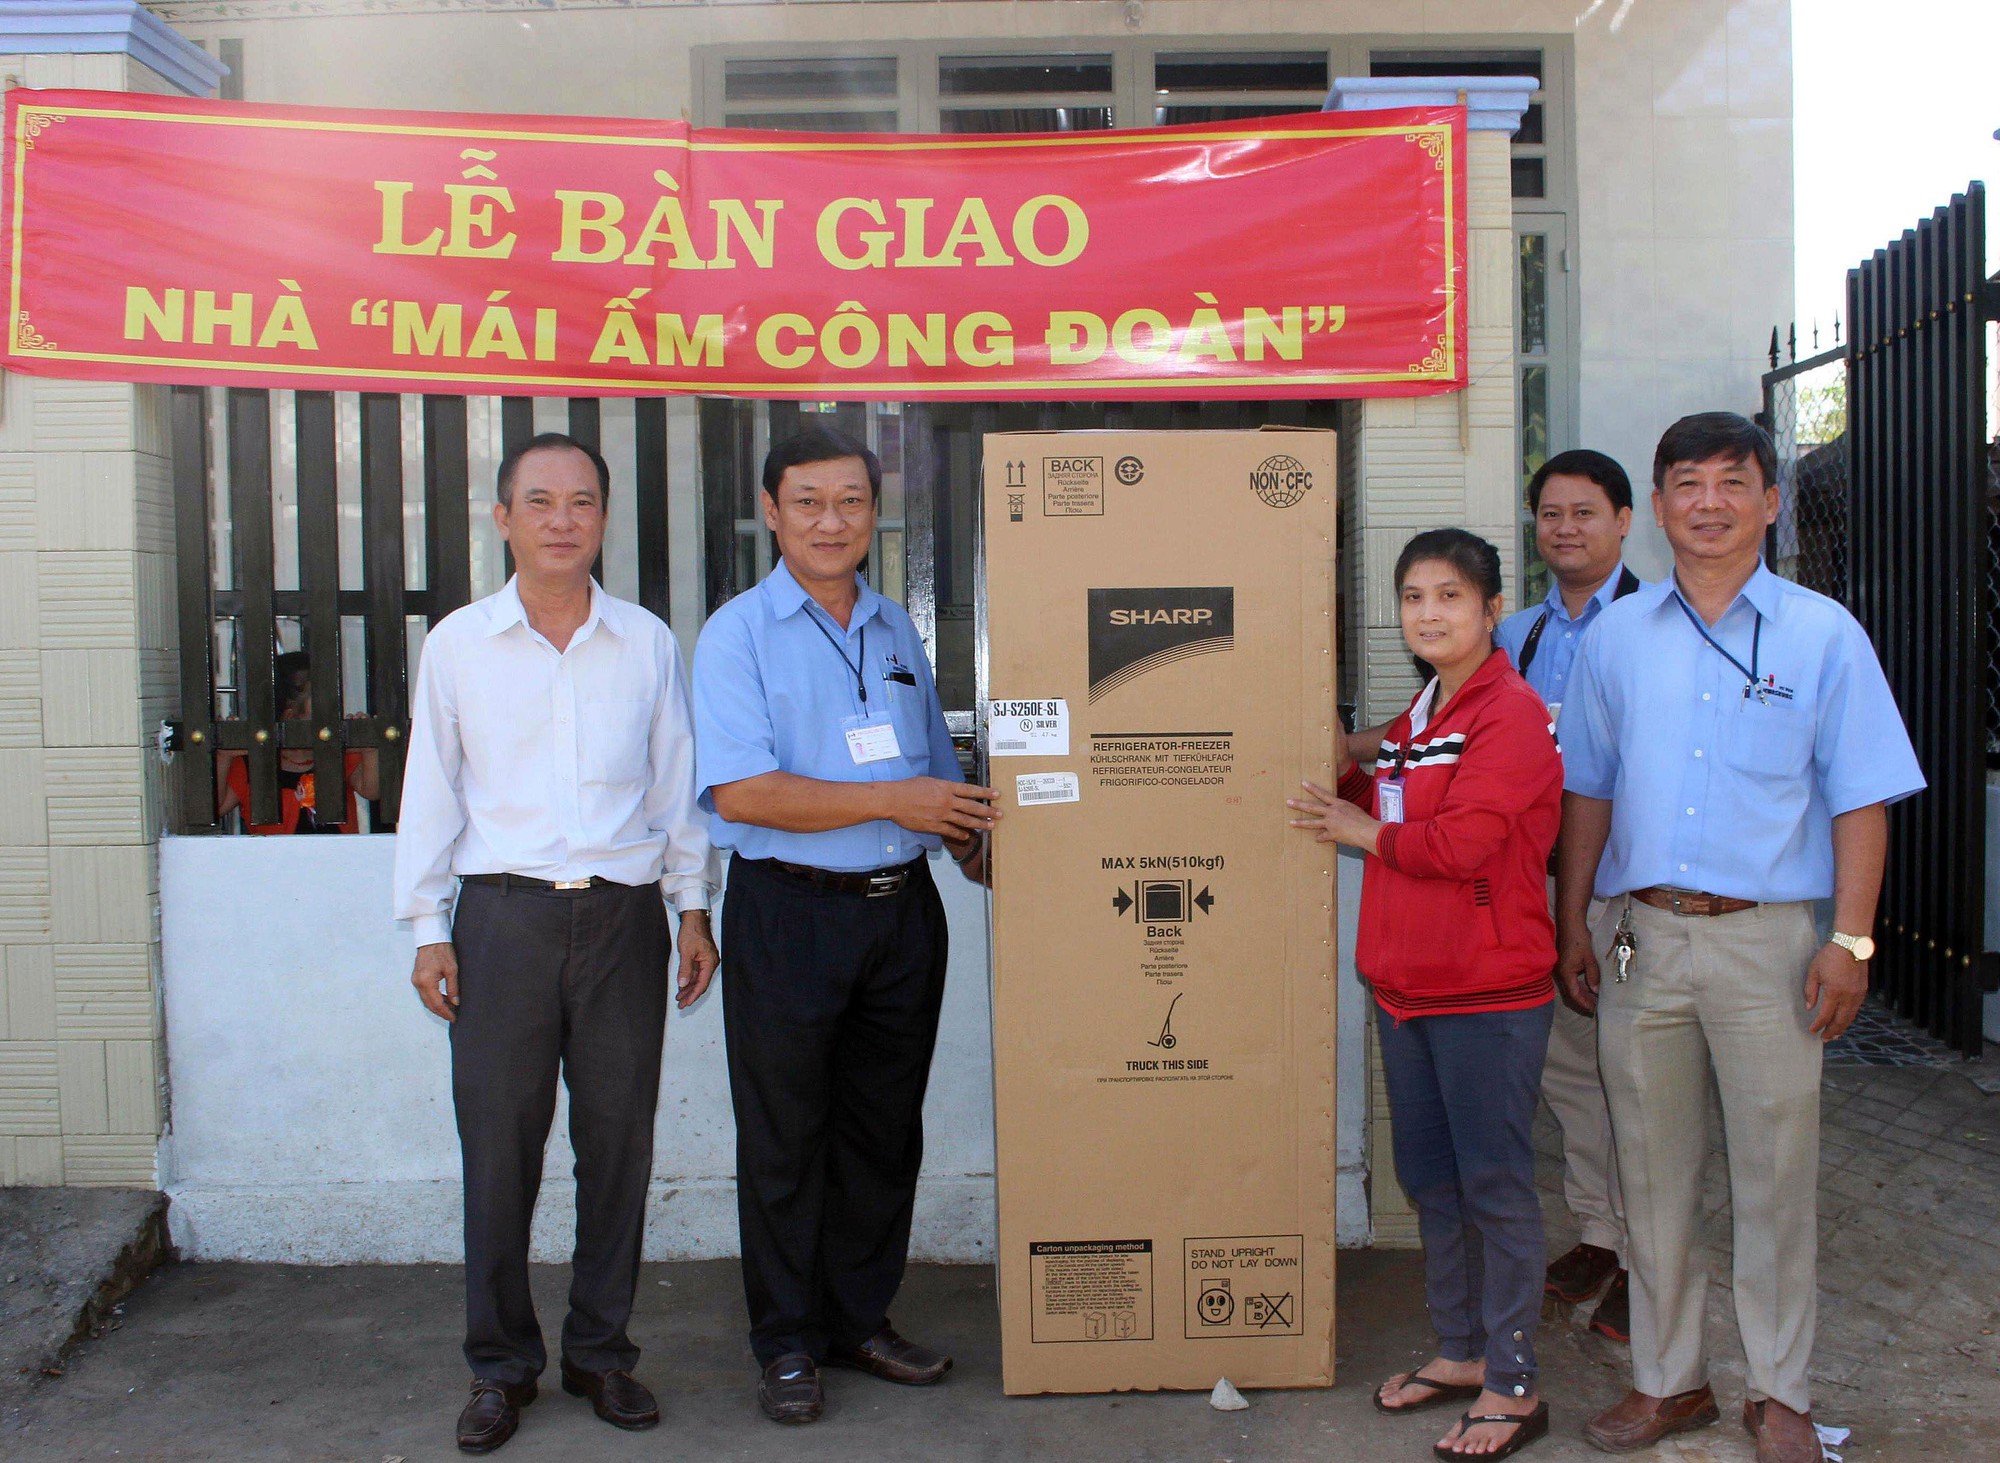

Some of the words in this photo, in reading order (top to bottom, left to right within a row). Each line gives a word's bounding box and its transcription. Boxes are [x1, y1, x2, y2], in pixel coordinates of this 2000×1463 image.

[372, 147, 518, 260] LỄ
[551, 169, 785, 271] BÀN
[815, 194, 1090, 271] GIAO
[123, 279, 319, 351] NHÀ
[589, 287, 725, 367] ẤM
[755, 300, 1015, 370] CÔNG
[1051, 459, 1094, 472] BACK
[1067, 493, 1099, 502] posteriore
[1109, 609, 1213, 625] SHARP
[993, 702, 1059, 716] SJ-S250E-SL
[1036, 720, 1057, 729] SILVER
[1093, 741, 1231, 752] REFRIGERATOR-FREEZER
[1090, 754, 1151, 764] KÜHLSCHRANK
[1155, 754, 1169, 763] MIT
[1173, 753, 1234, 763] TIEFKÜHLFACH
[1092, 765, 1232, 775] REFRIGERATEUR-CONGELATEUR
[1100, 777, 1224, 787] FRIGORIFICO-CONGELADOR
[1101, 857, 1136, 870] MAX
[1139, 855, 1225, 870] 5kN(510kgf)
[1147, 926, 1182, 938] Back
[1126, 1060, 1159, 1071] TRUCK
[1162, 1060, 1184, 1070] THIS
[1187, 1059, 1209, 1069] SIDE
[1036, 1245, 1063, 1253] Carton
[1064, 1244, 1114, 1253] unpackaging
[1115, 1242, 1145, 1251] method
[1191, 1249, 1226, 1259] STAND
[1231, 1247, 1276, 1257] UPRIGHT
[1191, 1260, 1208, 1270] DO
[1212, 1260, 1234, 1269] NOT
[1240, 1259, 1259, 1268] LAY
[1264, 1257, 1298, 1267] DOWN
